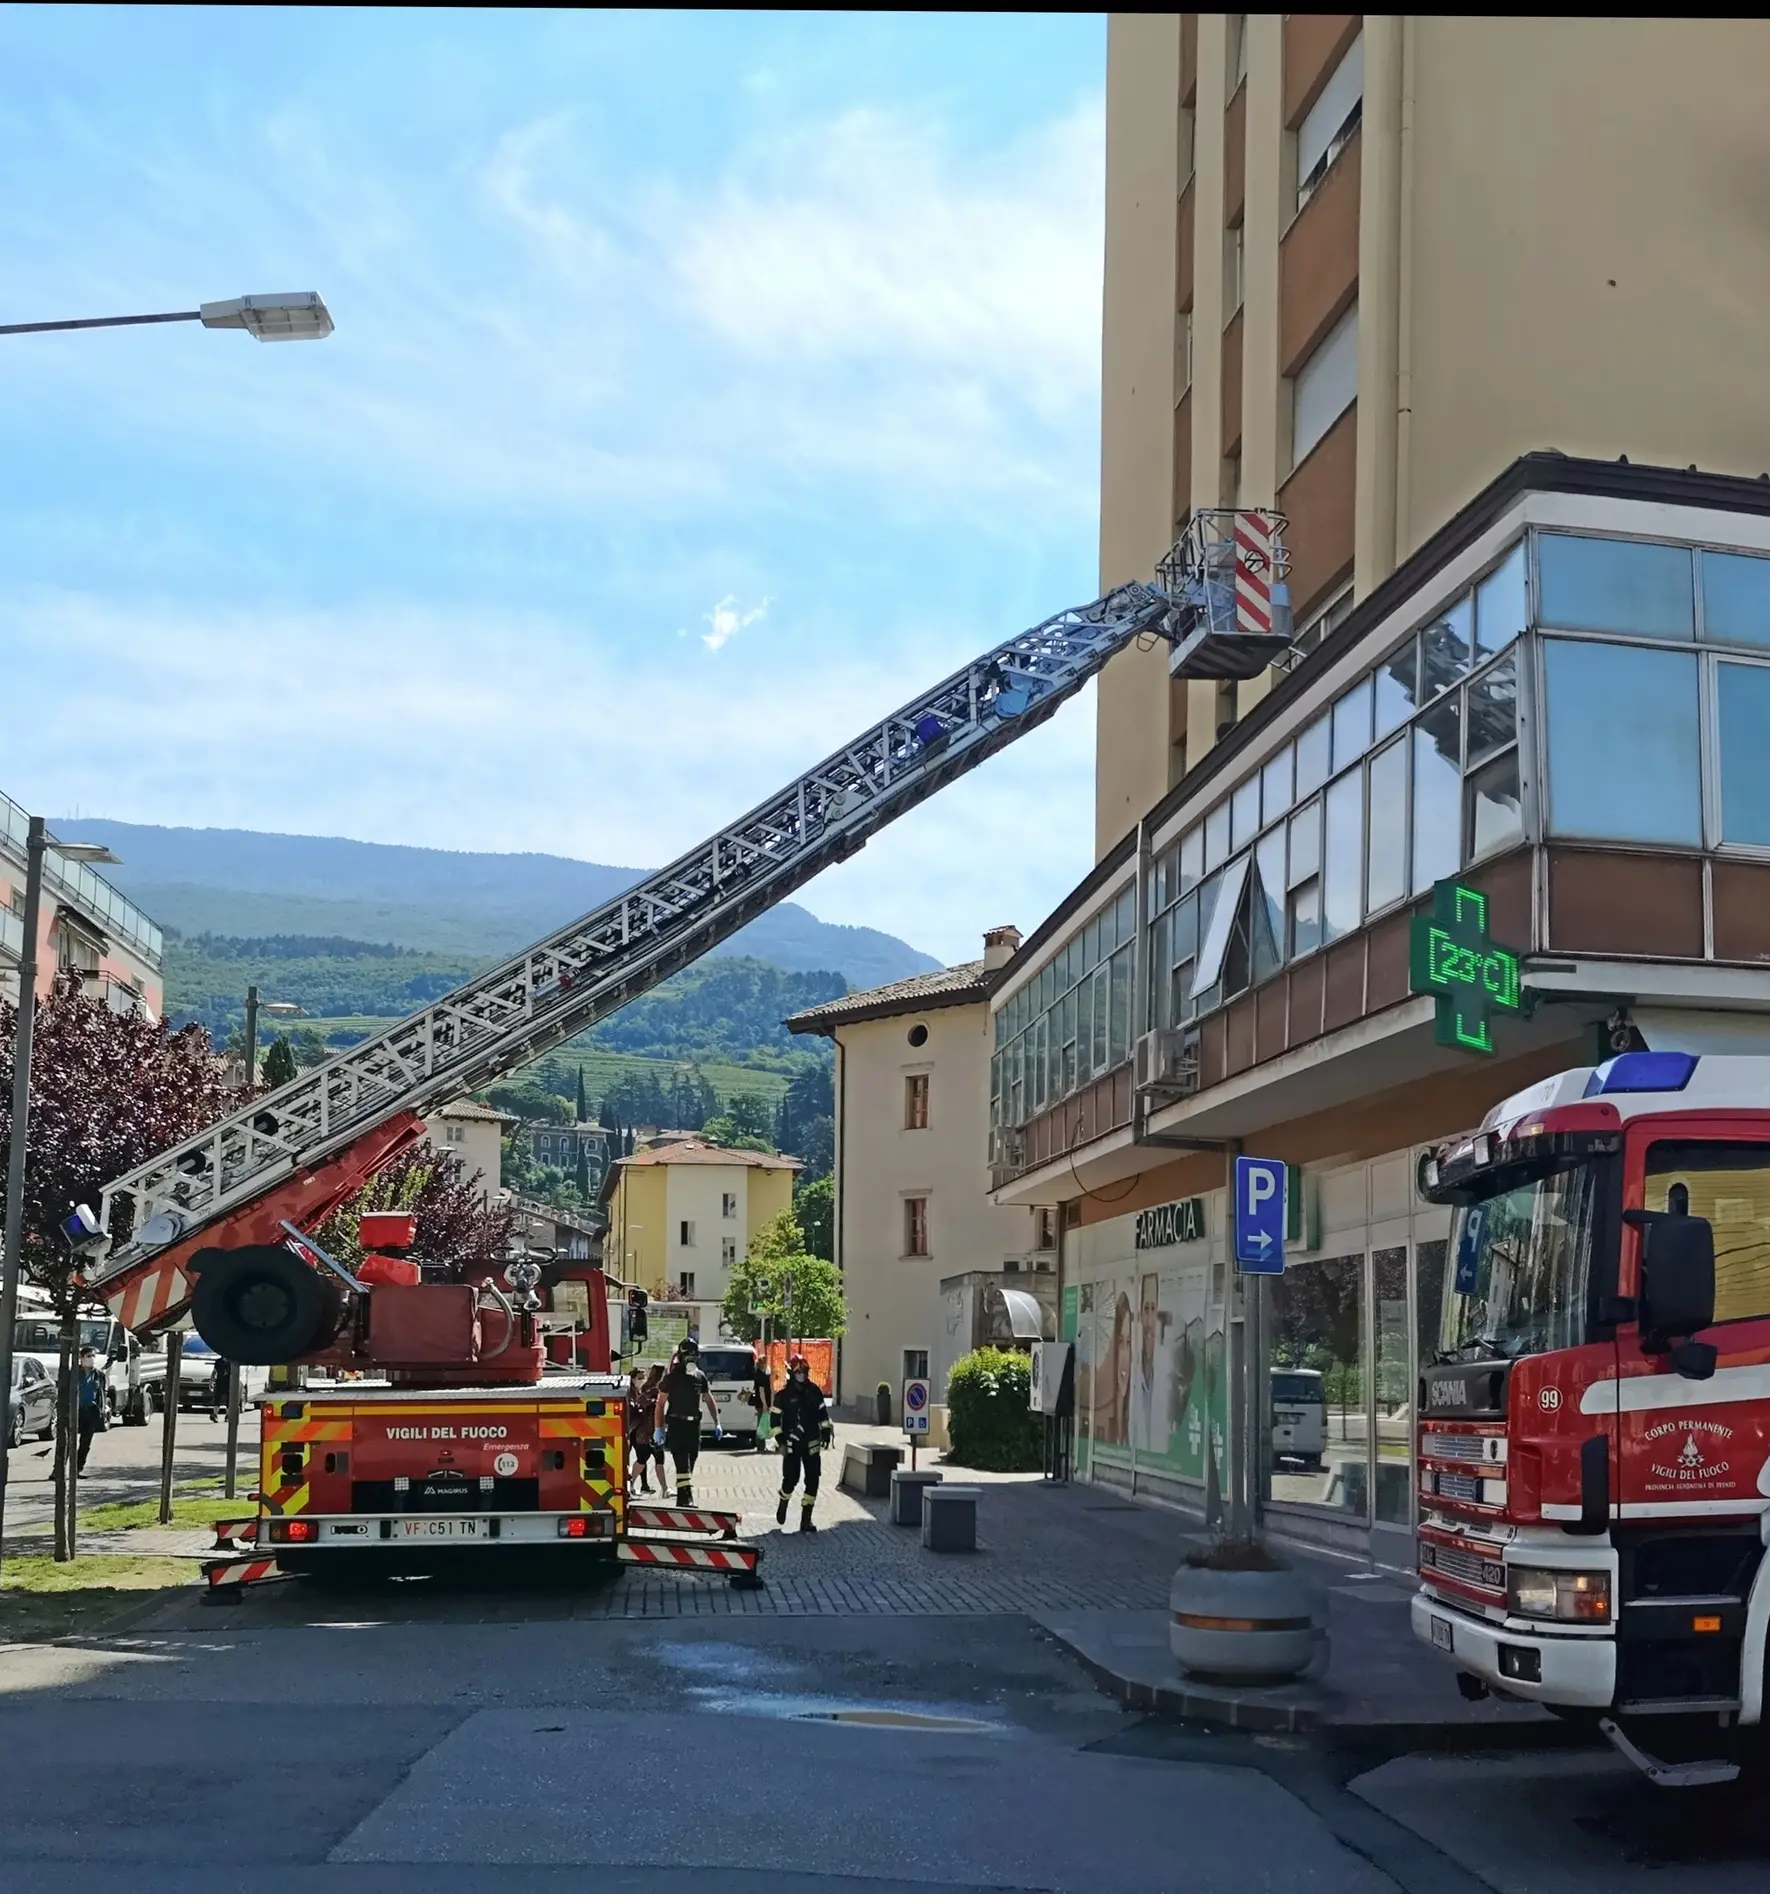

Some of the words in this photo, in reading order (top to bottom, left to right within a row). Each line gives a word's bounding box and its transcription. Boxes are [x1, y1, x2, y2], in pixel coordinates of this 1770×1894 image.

[1248, 1167, 1275, 1215] P
[1135, 1200, 1197, 1249] FARMACIA
[1432, 1380, 1466, 1406] SCANIA
[1541, 1390, 1558, 1409] 99
[386, 1427, 427, 1439] VIGILI
[431, 1427, 457, 1439] DEL
[461, 1426, 507, 1439] FUOCO
[1644, 1422, 1675, 1441] CORPO
[1678, 1420, 1733, 1439] PERMANENTE
[483, 1443, 529, 1451] Emergenza
[1651, 1463, 1677, 1478] VIGILI
[1680, 1470, 1696, 1479] DEL
[1699, 1461, 1729, 1478] FUOCO
[405, 1523, 420, 1535] VF
[429, 1522, 453, 1535] C51
[460, 1521, 476, 1535] TN
[1482, 1564, 1501, 1585] 420
